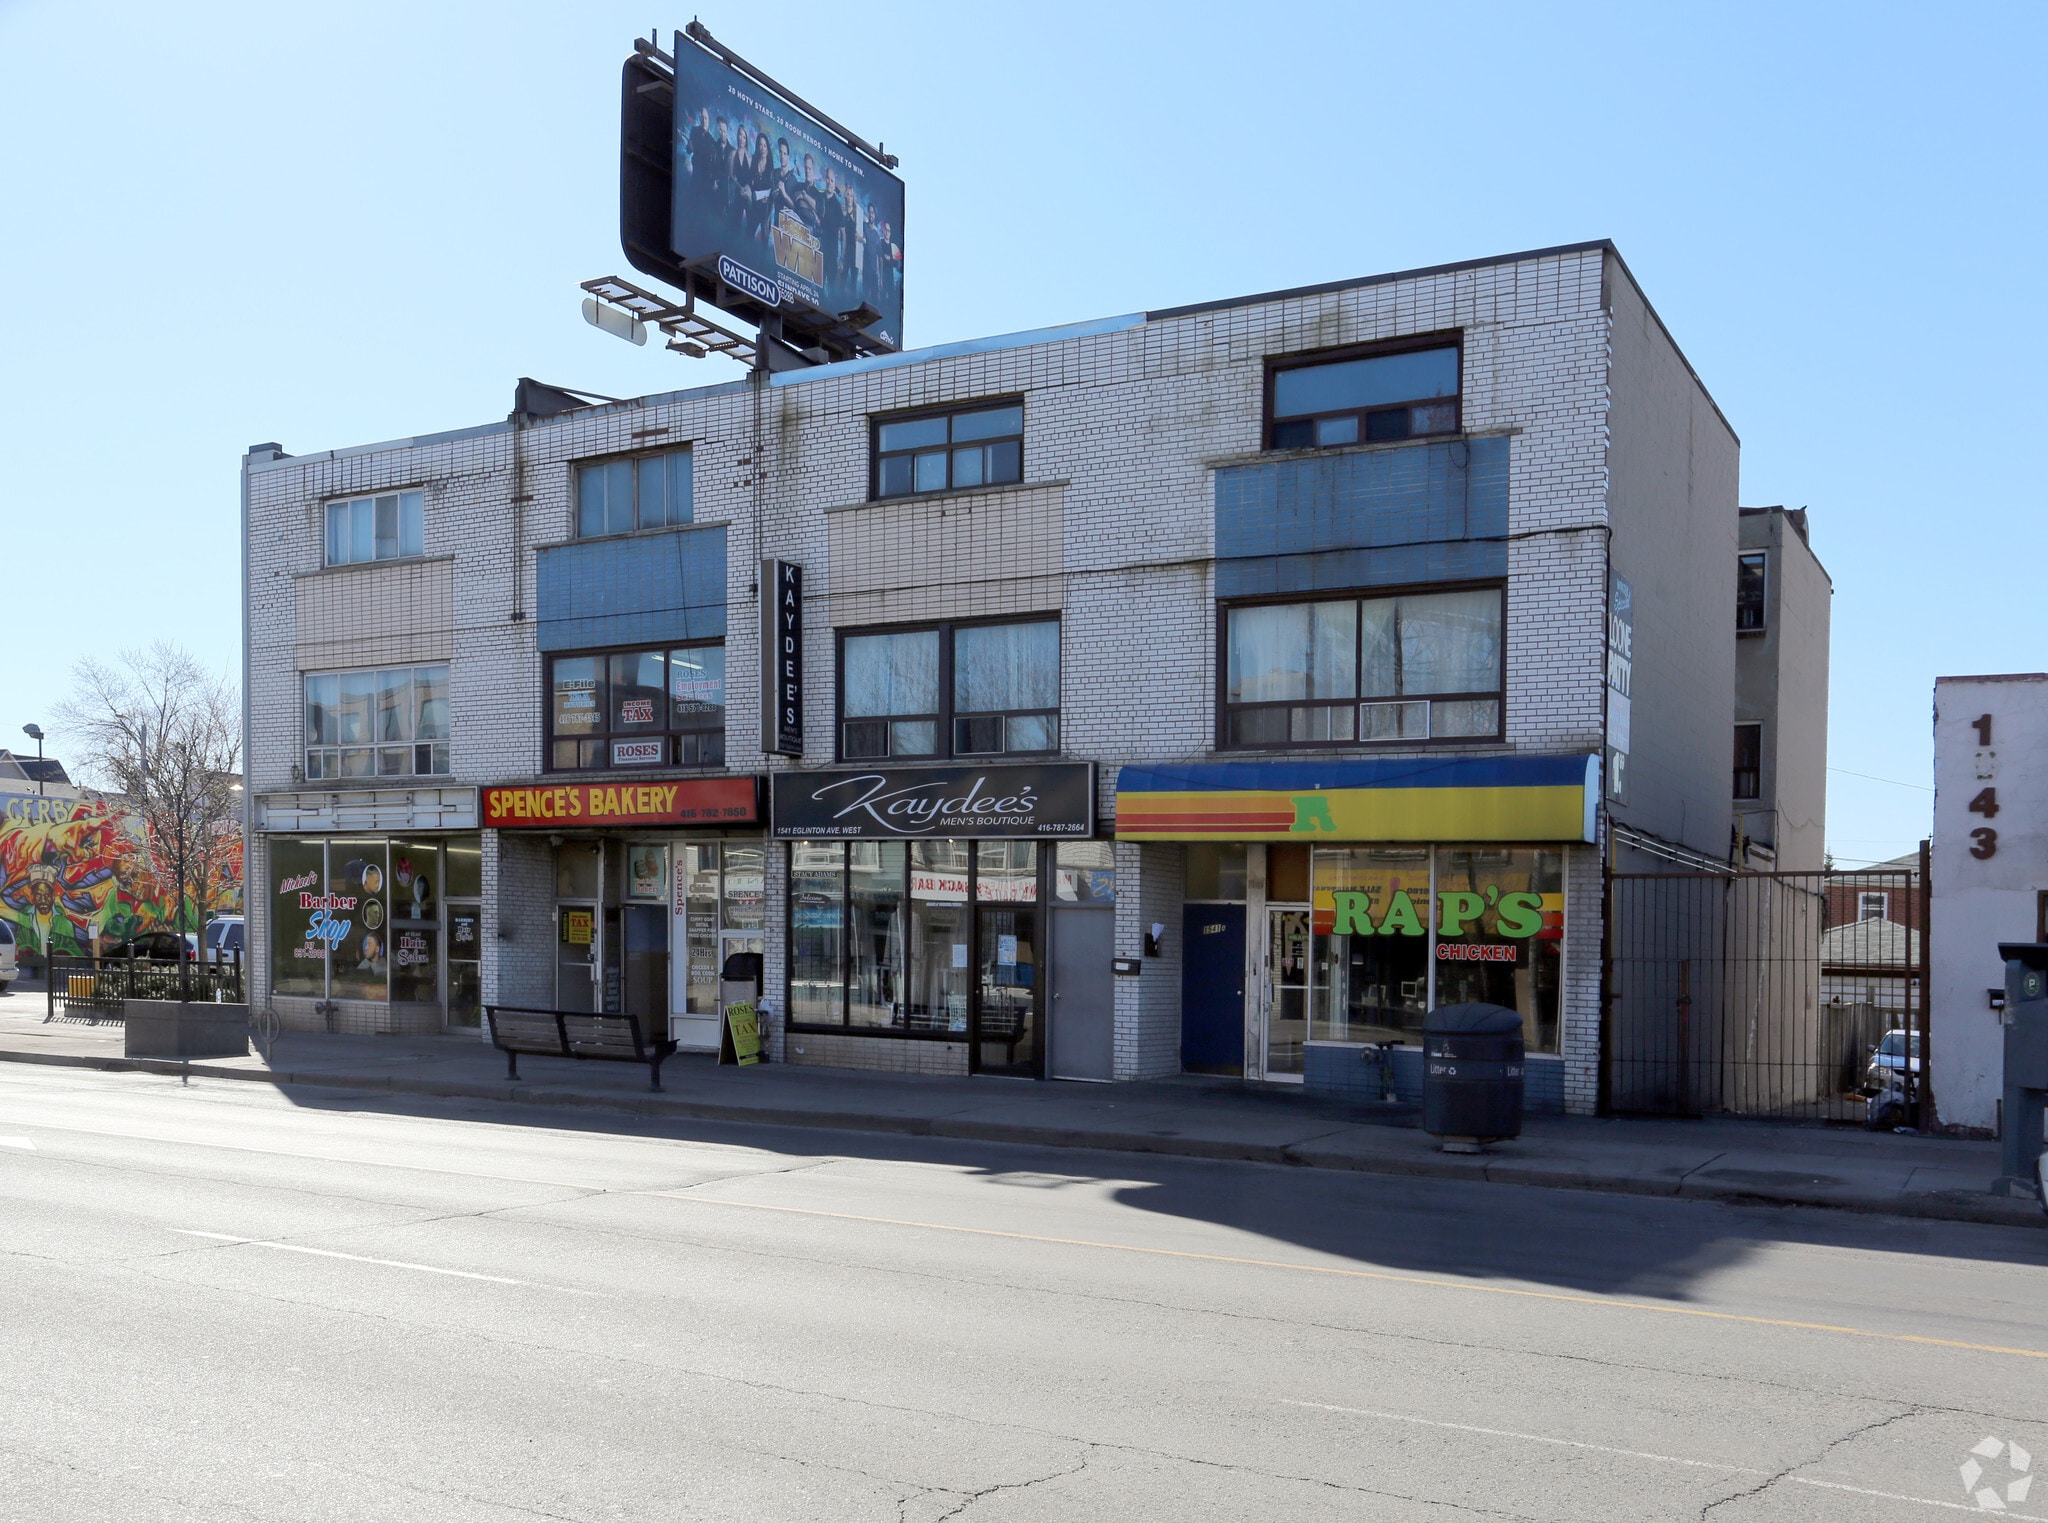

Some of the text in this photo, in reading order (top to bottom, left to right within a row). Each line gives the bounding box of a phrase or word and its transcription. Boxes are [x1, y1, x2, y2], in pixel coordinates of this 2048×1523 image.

[728, 85, 736, 95] 20
[737, 90, 754, 106] HGTV
[754, 101, 775, 120] STARS.
[776, 115, 784, 126] 20
[785, 121, 801, 137] ROOM
[802, 131, 823, 150] RENOS.
[828, 147, 843, 164] HOME
[845, 159, 852, 168] TO
[771, 225, 824, 288] WIN
[723, 260, 776, 302] PATTISON
[777, 271, 800, 289] STARTING
[785, 565, 798, 725] KAYDEE'S
[677, 669, 706, 679] ROSES
[1608, 649, 1632, 697] PATTY
[676, 679, 721, 692] Employment
[569, 691, 590, 701] TAX
[676, 691, 713, 702] Services
[623, 700, 651, 708] INCOME
[622, 707, 653, 723] TAX
[617, 744, 659, 757] ROSES
[489, 785, 679, 818] SPENCE'S BAKERY
[811, 775, 1038, 833] Kaydee's
[940, 815, 1035, 826] MEN'S BOUTIQUE
[1288, 796, 1337, 832] R
[777, 825, 862, 835] 1541 EGLINTON AVE. WEST
[1037, 823, 1085, 833] 416-787-2664
[280, 870, 318, 894] Michael's
[675, 859, 684, 915] Spence's
[299, 892, 358, 910] Barber
[728, 890, 765, 898] SPENCE'S
[1331, 884, 1544, 939] RAP'S
[305, 910, 351, 951] Shop
[571, 918, 589, 928] TAX
[400, 936, 426, 948] Hair
[398, 949, 429, 966] Salon
[1436, 943, 1517, 962] CHICKEN
[693, 976, 713, 984] SOUP
[2029, 979, 2036, 988] P
[727, 1003, 755, 1017] ROSES
[734, 1022, 757, 1036] TAX
[1430, 1063, 1447, 1075] Litter
